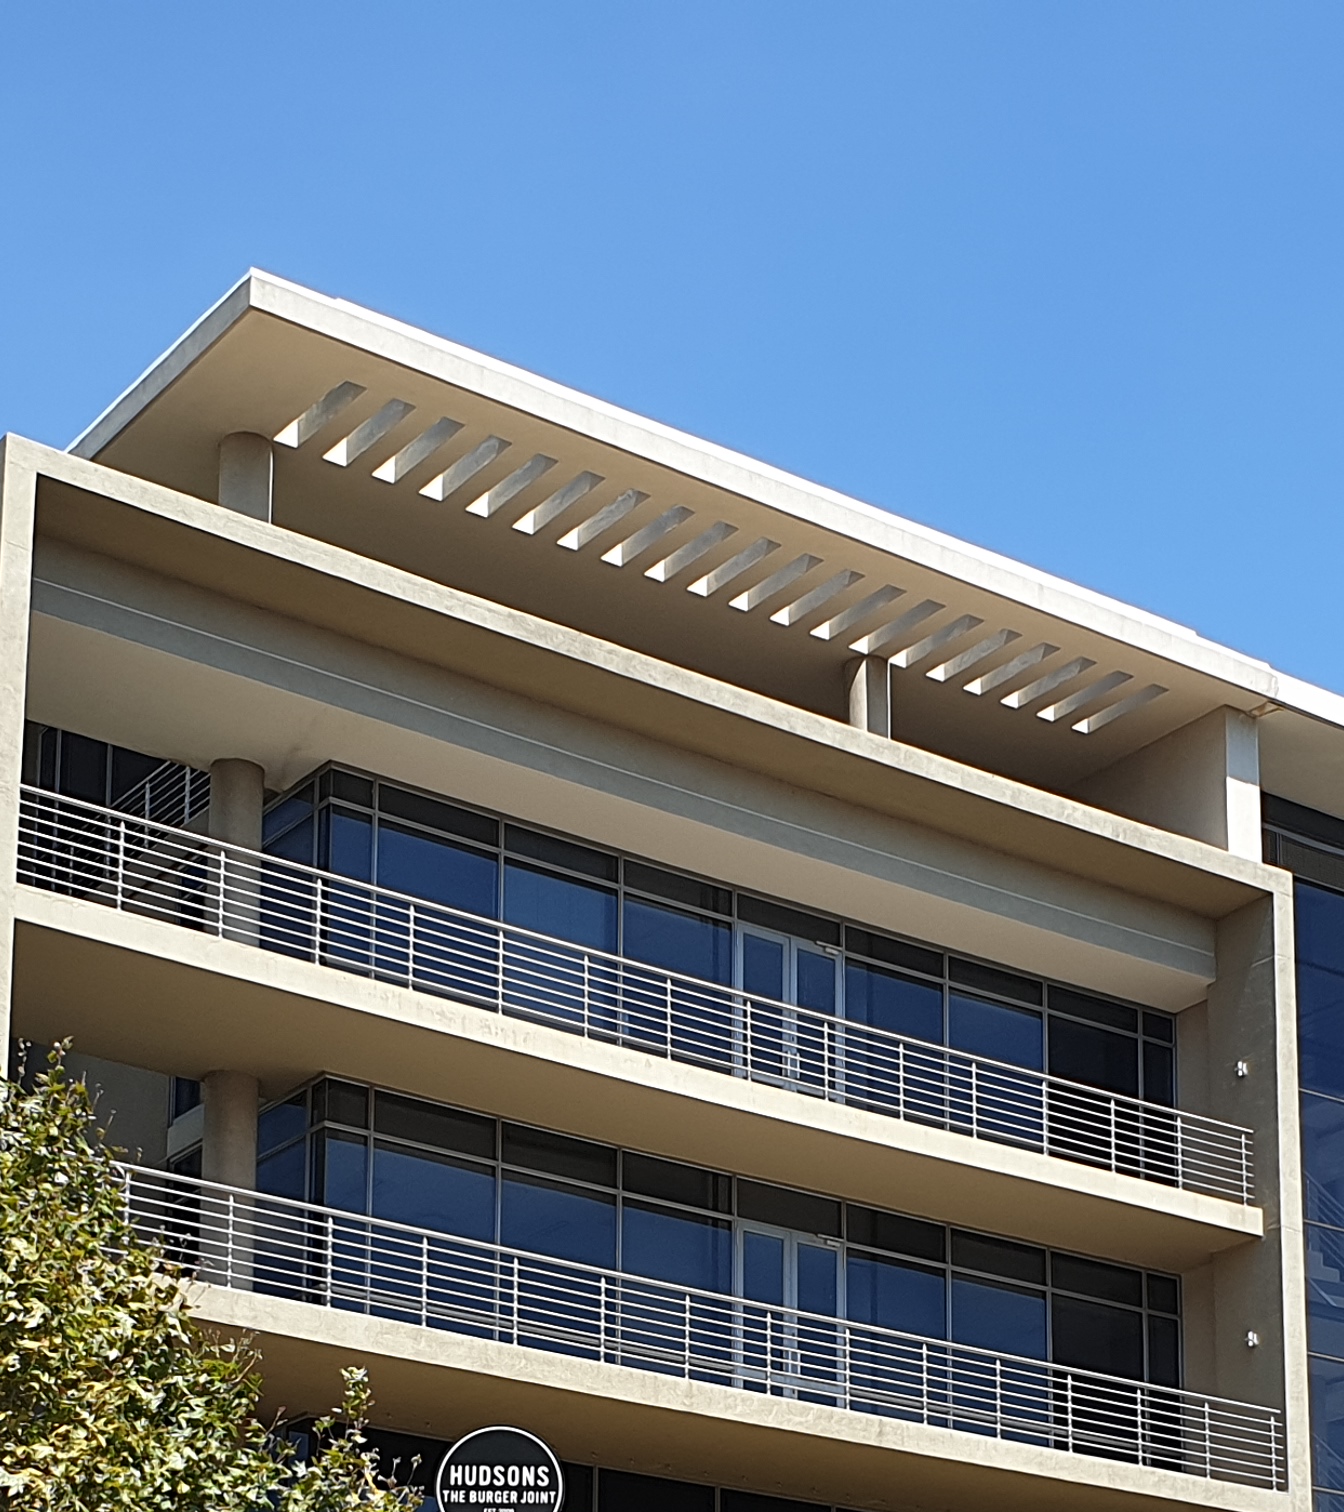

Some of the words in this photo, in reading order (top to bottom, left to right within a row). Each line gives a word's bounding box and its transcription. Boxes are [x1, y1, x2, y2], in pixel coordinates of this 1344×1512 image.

[449, 1464, 550, 1487] HUDSONS
[442, 1489, 466, 1504] THE
[469, 1490, 518, 1504] BURGER
[520, 1490, 556, 1504] JOINT
